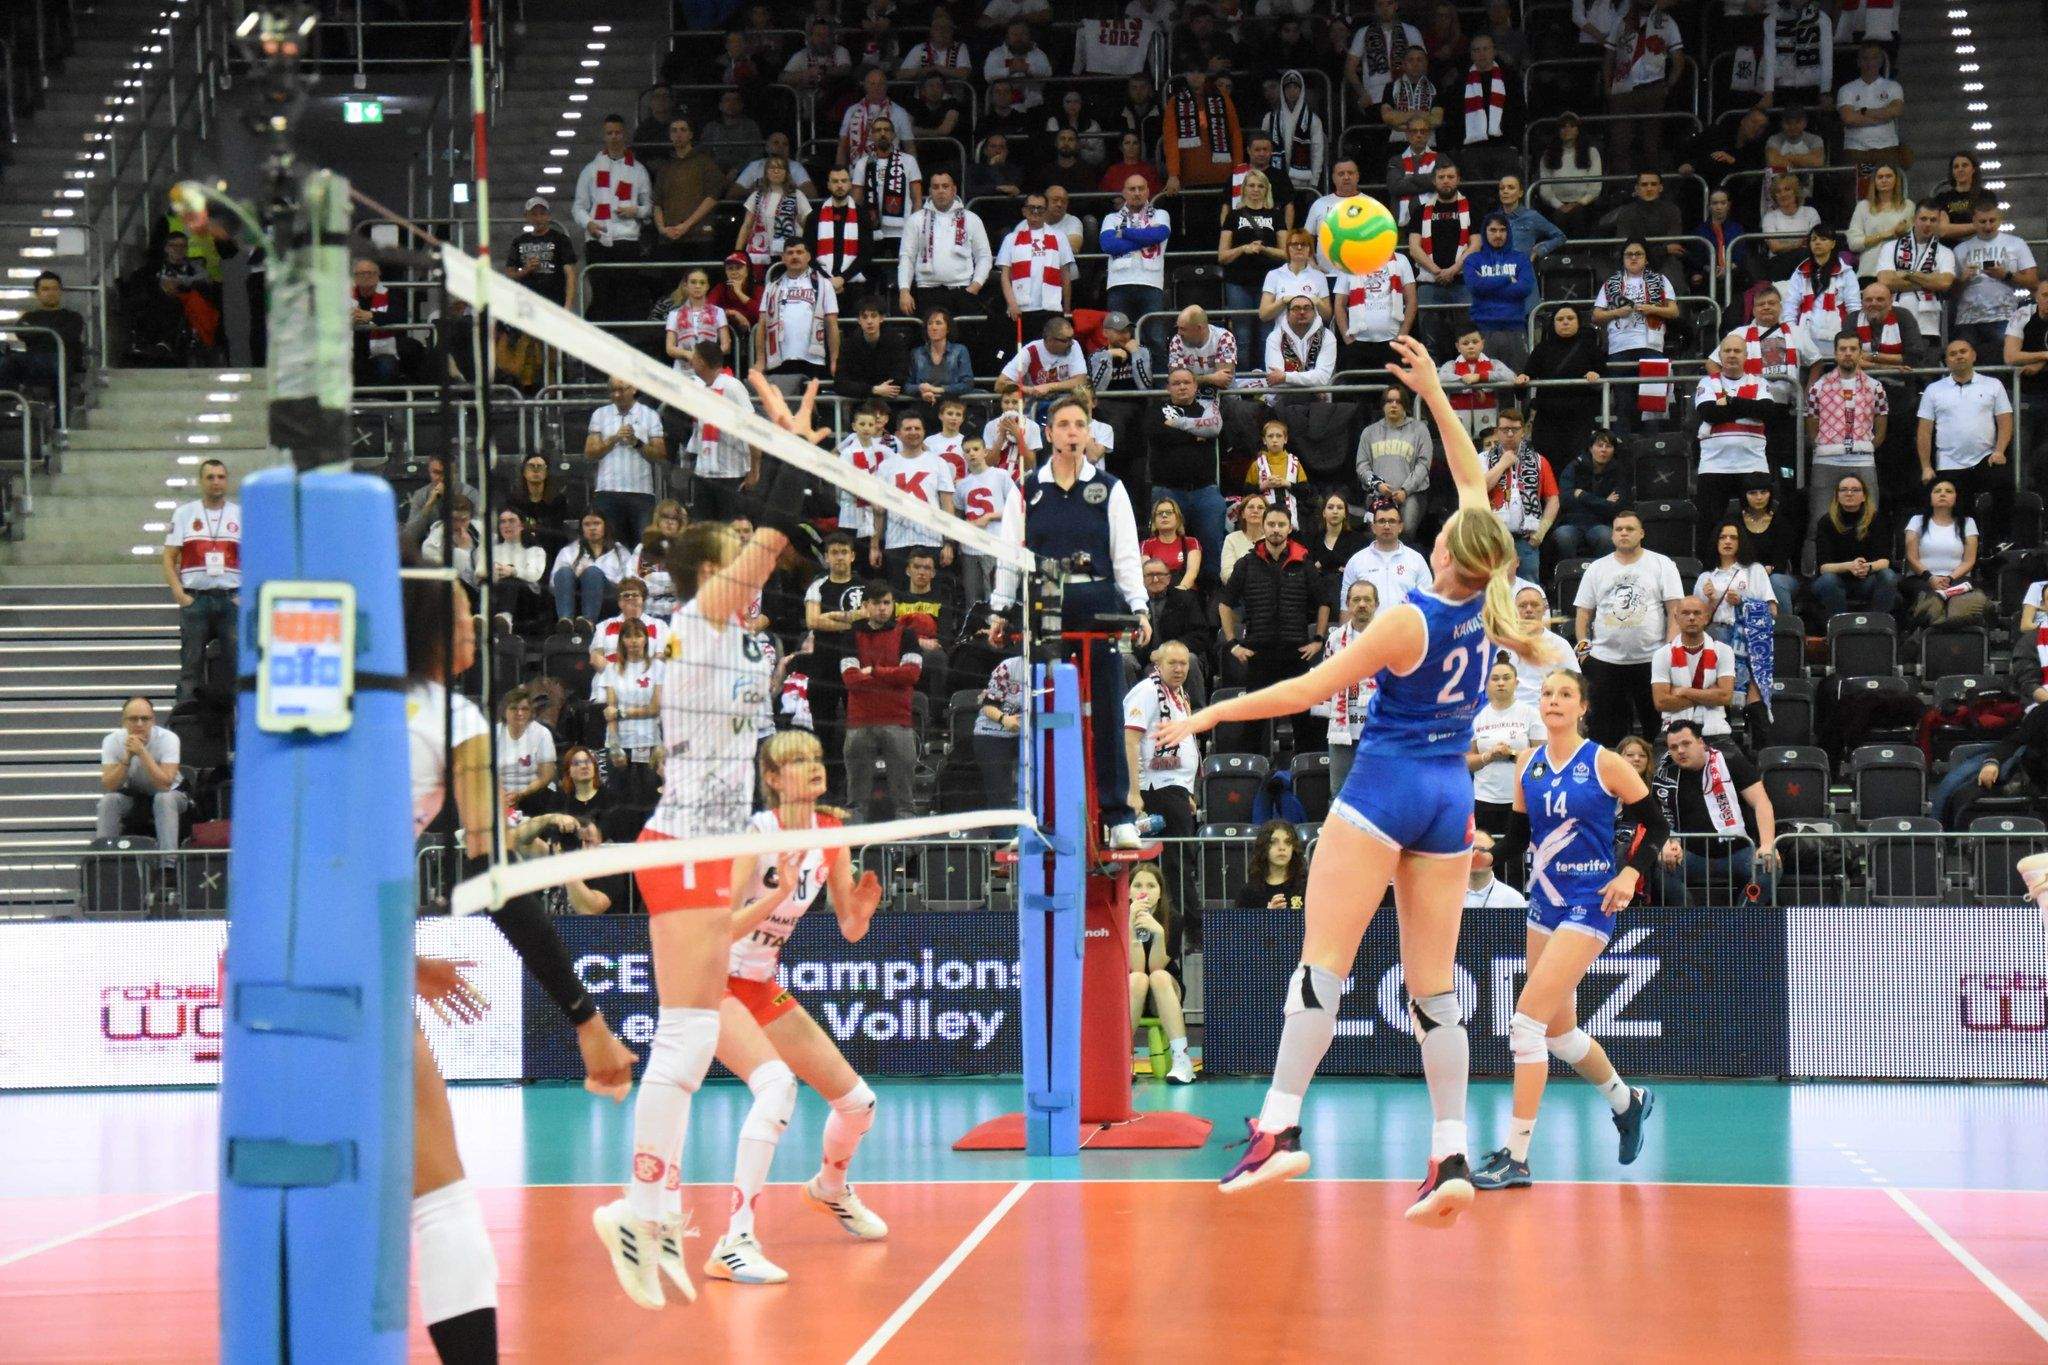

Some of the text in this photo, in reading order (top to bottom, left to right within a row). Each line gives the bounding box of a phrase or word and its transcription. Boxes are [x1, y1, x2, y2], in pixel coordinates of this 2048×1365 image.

[1966, 246, 2008, 261] ARMIA
[895, 471, 930, 503] K
[965, 487, 994, 521] S
[1453, 613, 1484, 639] KANAS
[1437, 638, 1490, 704] 21
[1542, 790, 1568, 818] 14
[1555, 858, 1608, 873] tenerife
[1085, 927, 1110, 937] noh
[574, 949, 1021, 1000] CE ampion
[823, 999, 1004, 1050] Volley
